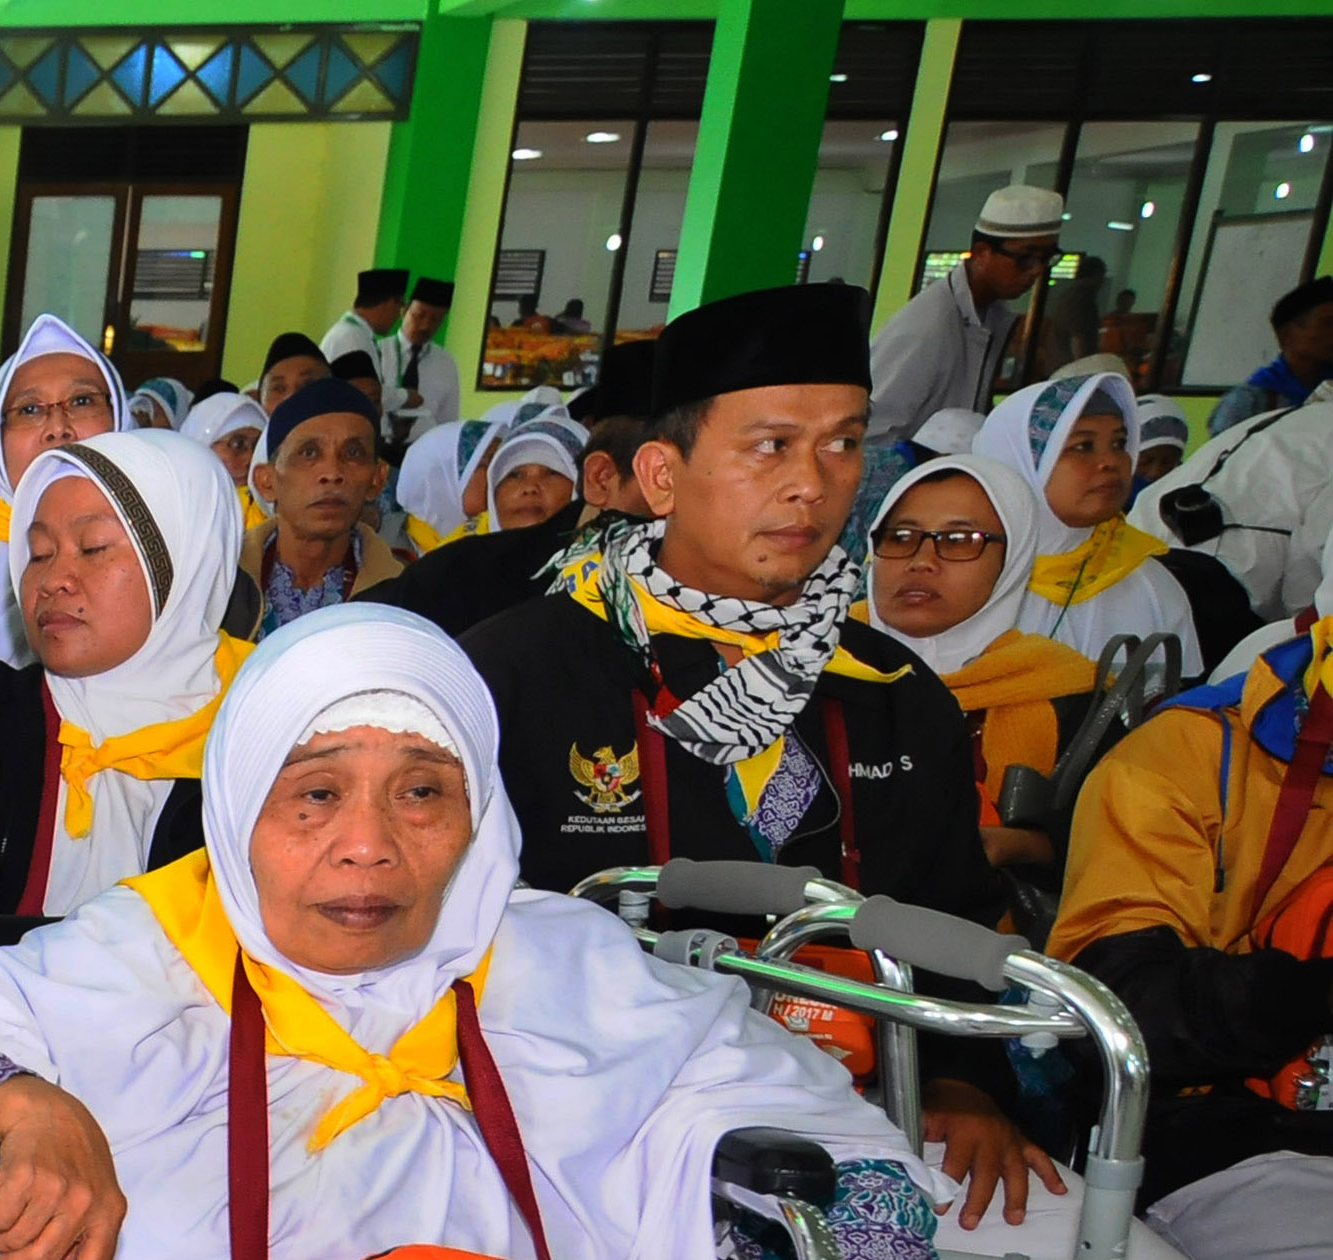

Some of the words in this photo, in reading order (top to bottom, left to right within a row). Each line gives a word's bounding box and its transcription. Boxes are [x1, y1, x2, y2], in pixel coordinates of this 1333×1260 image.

[848, 762, 893, 779] HMAD
[900, 755, 913, 771] S
[568, 816, 615, 824] KEDUTAAN
[560, 824, 605, 833] REPUBLIK
[607, 824, 646, 833] INDONES
[791, 1004, 820, 1019] 2017
